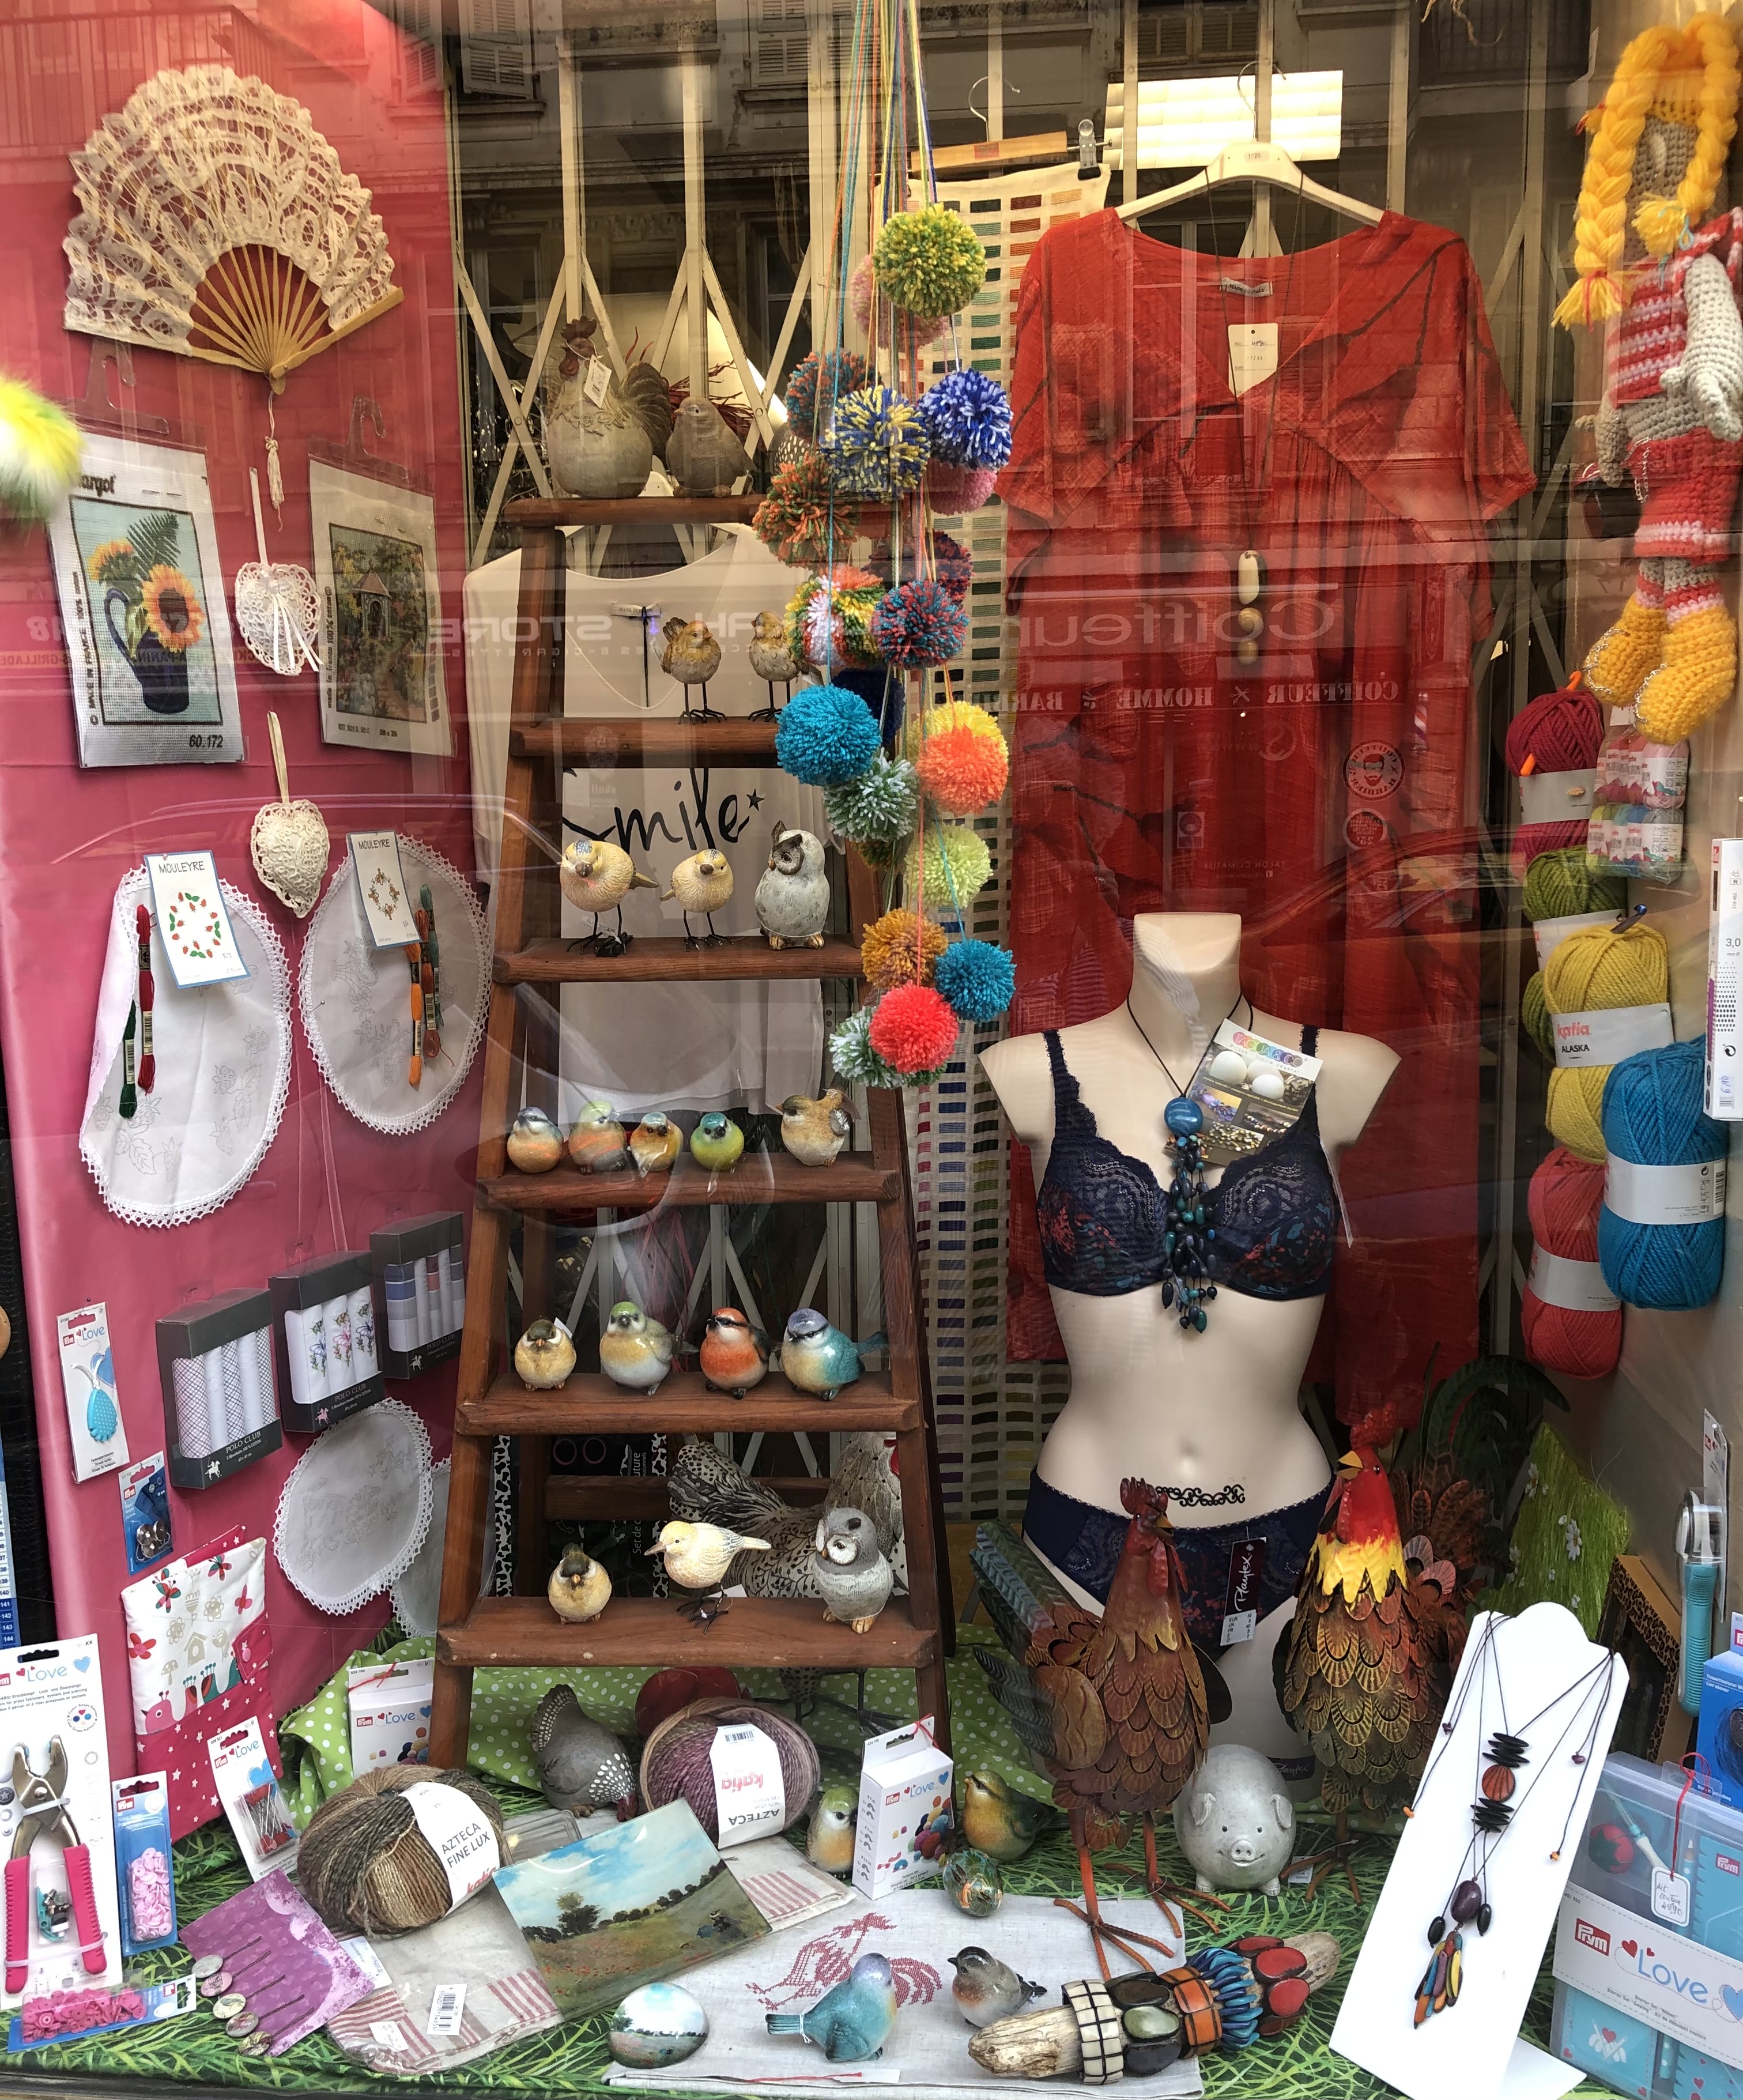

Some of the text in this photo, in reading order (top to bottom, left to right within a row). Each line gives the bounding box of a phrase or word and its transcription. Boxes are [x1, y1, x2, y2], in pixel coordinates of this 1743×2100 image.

[1229, 284, 1243, 292] MADE
[80, 474, 116, 497] argot
[79, 627, 93, 665] FRANCE
[189, 734, 224, 748] 60.172
[358, 838, 391, 850] MOULEYRE
[159, 861, 205, 874] MOULEYRE
[1725, 938, 1741, 948] 3,0
[1557, 1021, 1591, 1040] katia
[1561, 1044, 1590, 1053] ALASKA
[82, 1326, 106, 1341] Love
[427, 1341, 441, 1350] POLO
[334, 1383, 367, 1402] POLO CLUB
[225, 1431, 261, 1454] POLO CLUB
[633, 1529, 642, 1554] Set de
[1234, 1554, 1255, 1612] Playtex
[27, 1665, 68, 1682] Love
[386, 1712, 416, 1724] Love
[235, 1740, 260, 1758] Love
[721, 1773, 764, 1793] katia
[910, 1781, 935, 1798] Love
[728, 1808, 780, 1826] AZTECA
[442, 1823, 481, 1855] AZTECA
[447, 1831, 491, 1868] FINE LUX
[1717, 1857, 1739, 1874] Prym
[1577, 1924, 1608, 1952] Prym
[1638, 1948, 1708, 2004] Love
